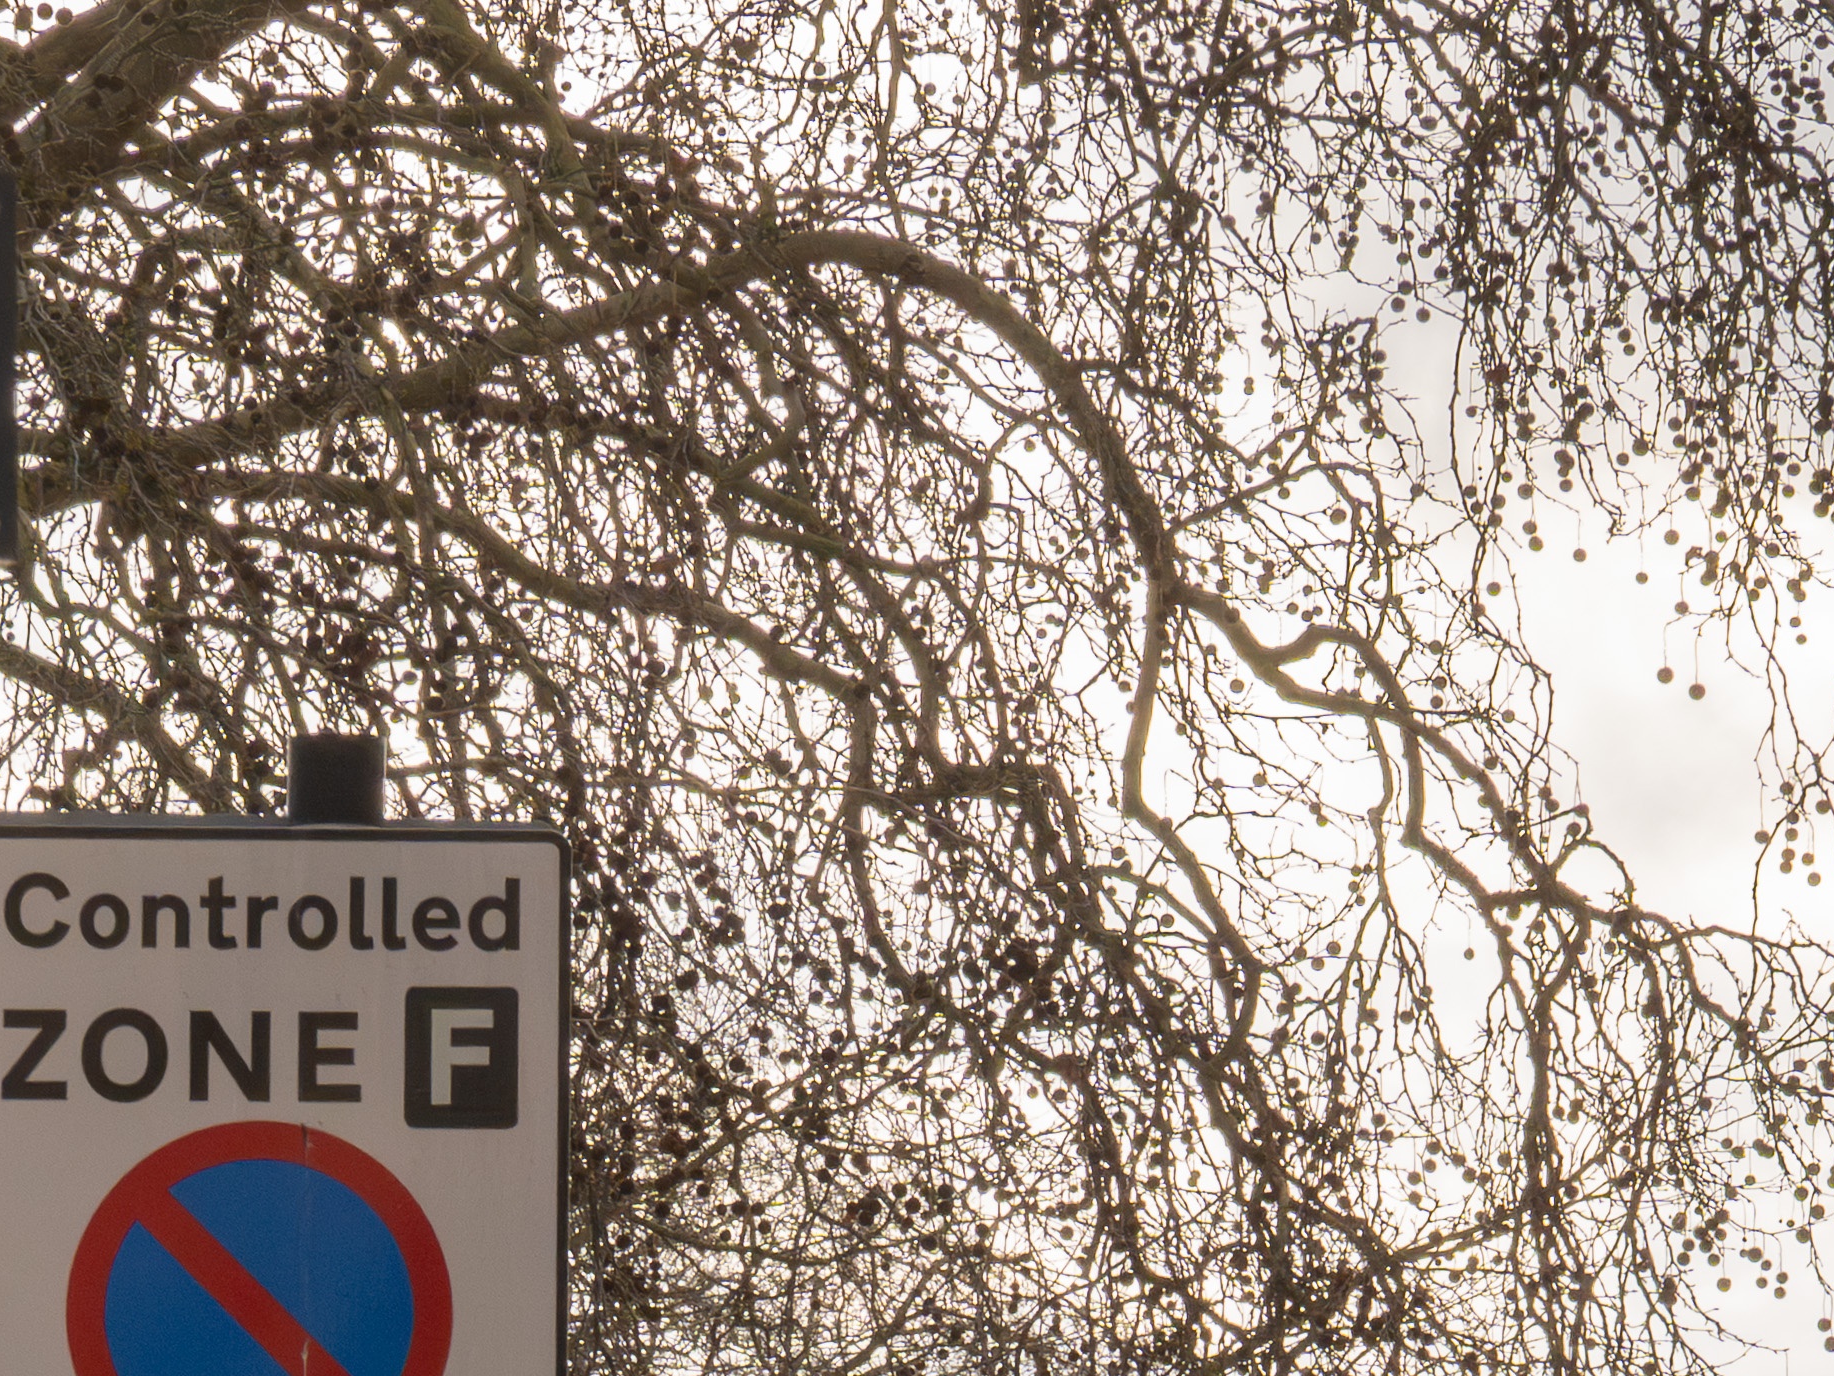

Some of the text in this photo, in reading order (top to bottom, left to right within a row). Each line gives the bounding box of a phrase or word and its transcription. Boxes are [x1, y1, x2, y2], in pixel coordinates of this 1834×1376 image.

[3, 871, 521, 951] Controlled
[1, 1007, 495, 1105] ZONE F
